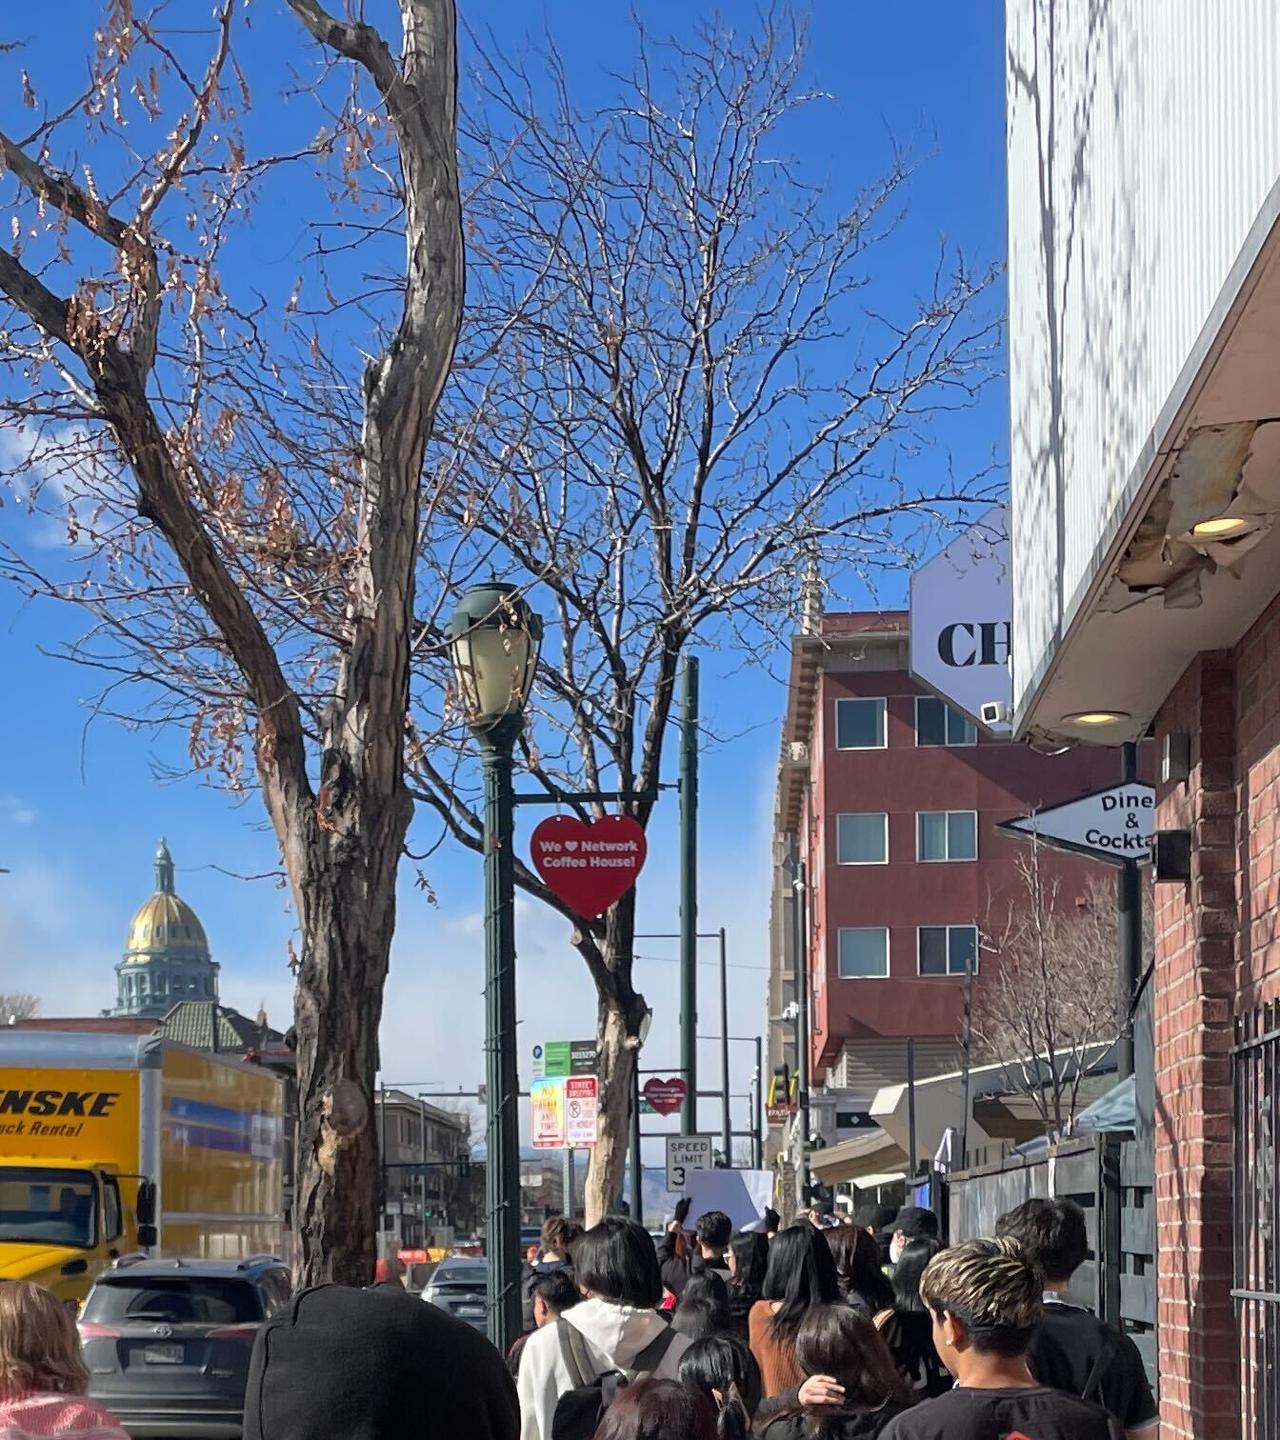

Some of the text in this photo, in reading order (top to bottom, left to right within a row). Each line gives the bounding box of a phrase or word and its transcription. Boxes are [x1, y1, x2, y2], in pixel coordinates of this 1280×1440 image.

[1101, 791, 1154, 812] Dine
[1125, 812, 1139, 829] &
[540, 840, 639, 853] We Network
[542, 856, 636, 868] Coffee House!
[28, 1121, 84, 1137] Rental
[670, 1142, 708, 1152] SPEED
[673, 1154, 703, 1163] LIMIT
[672, 1166, 704, 1186] 3
